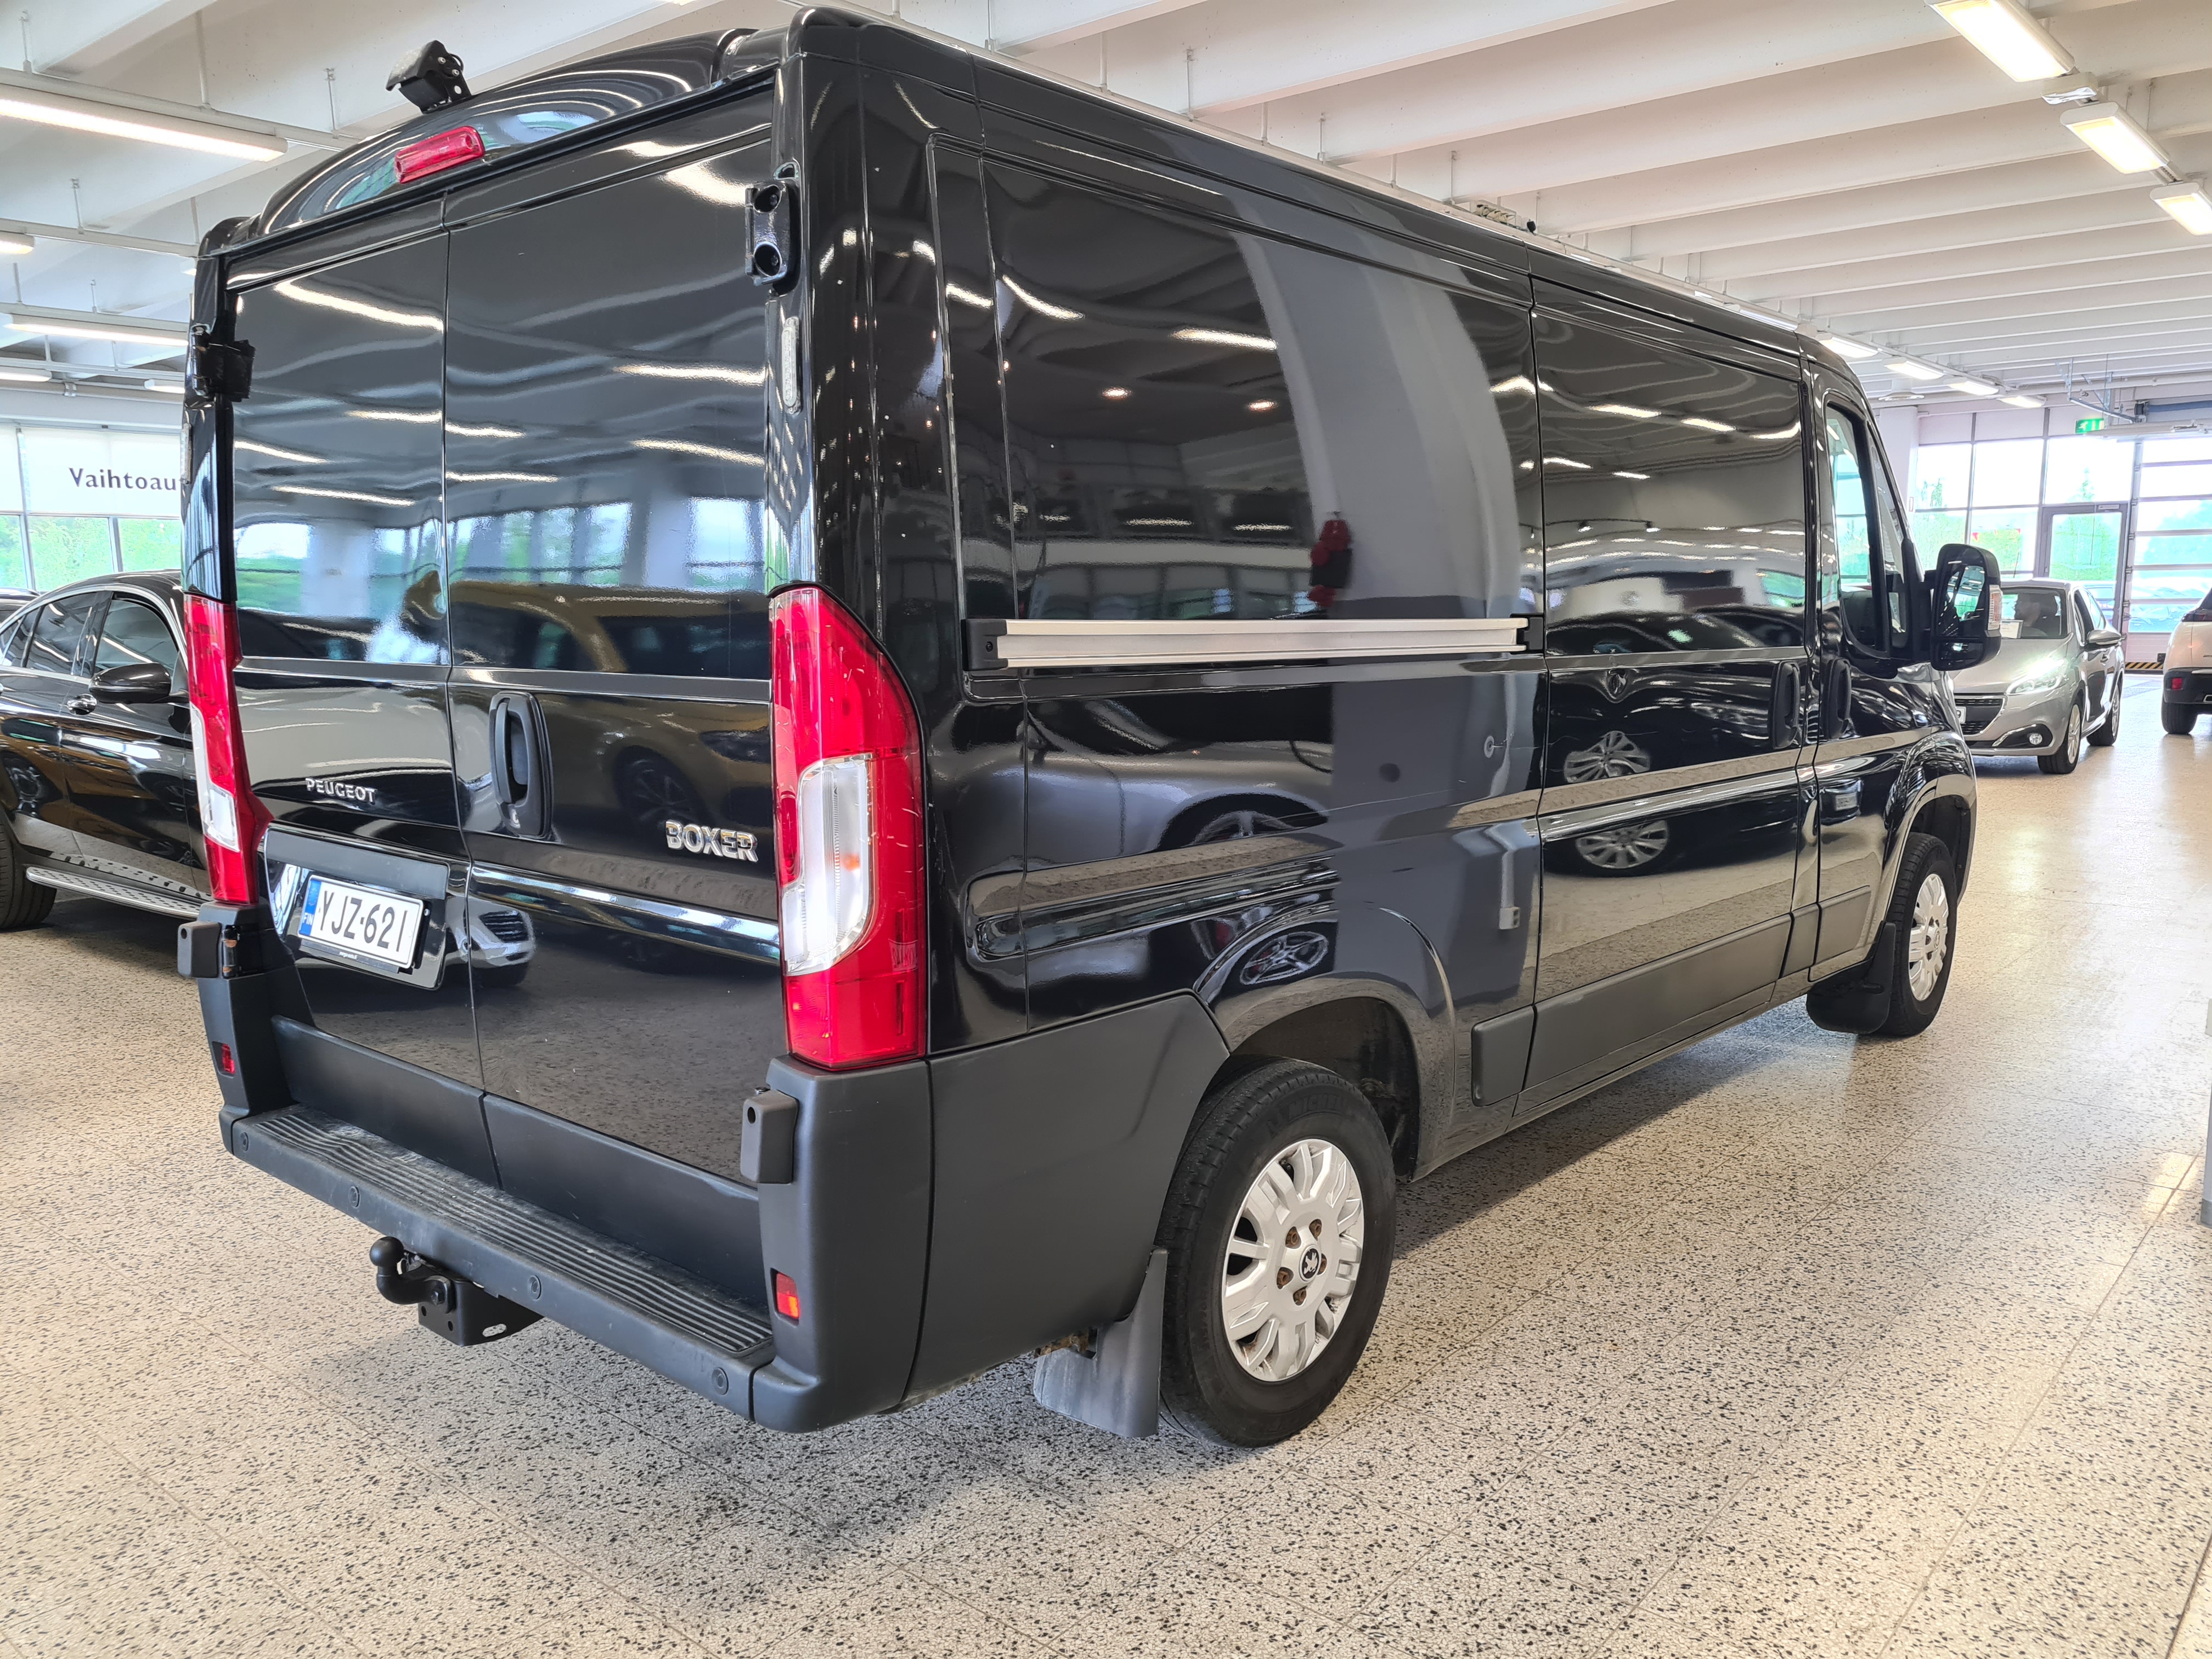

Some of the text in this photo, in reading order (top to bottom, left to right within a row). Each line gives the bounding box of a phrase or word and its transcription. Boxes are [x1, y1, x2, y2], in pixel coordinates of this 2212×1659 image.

[69, 467, 179, 491] Vaihtoau
[305, 777, 376, 804] PEUGEOT
[665, 819, 759, 862] BOXER
[302, 912, 314, 926] FIN
[320, 890, 408, 952] YJZ-621
